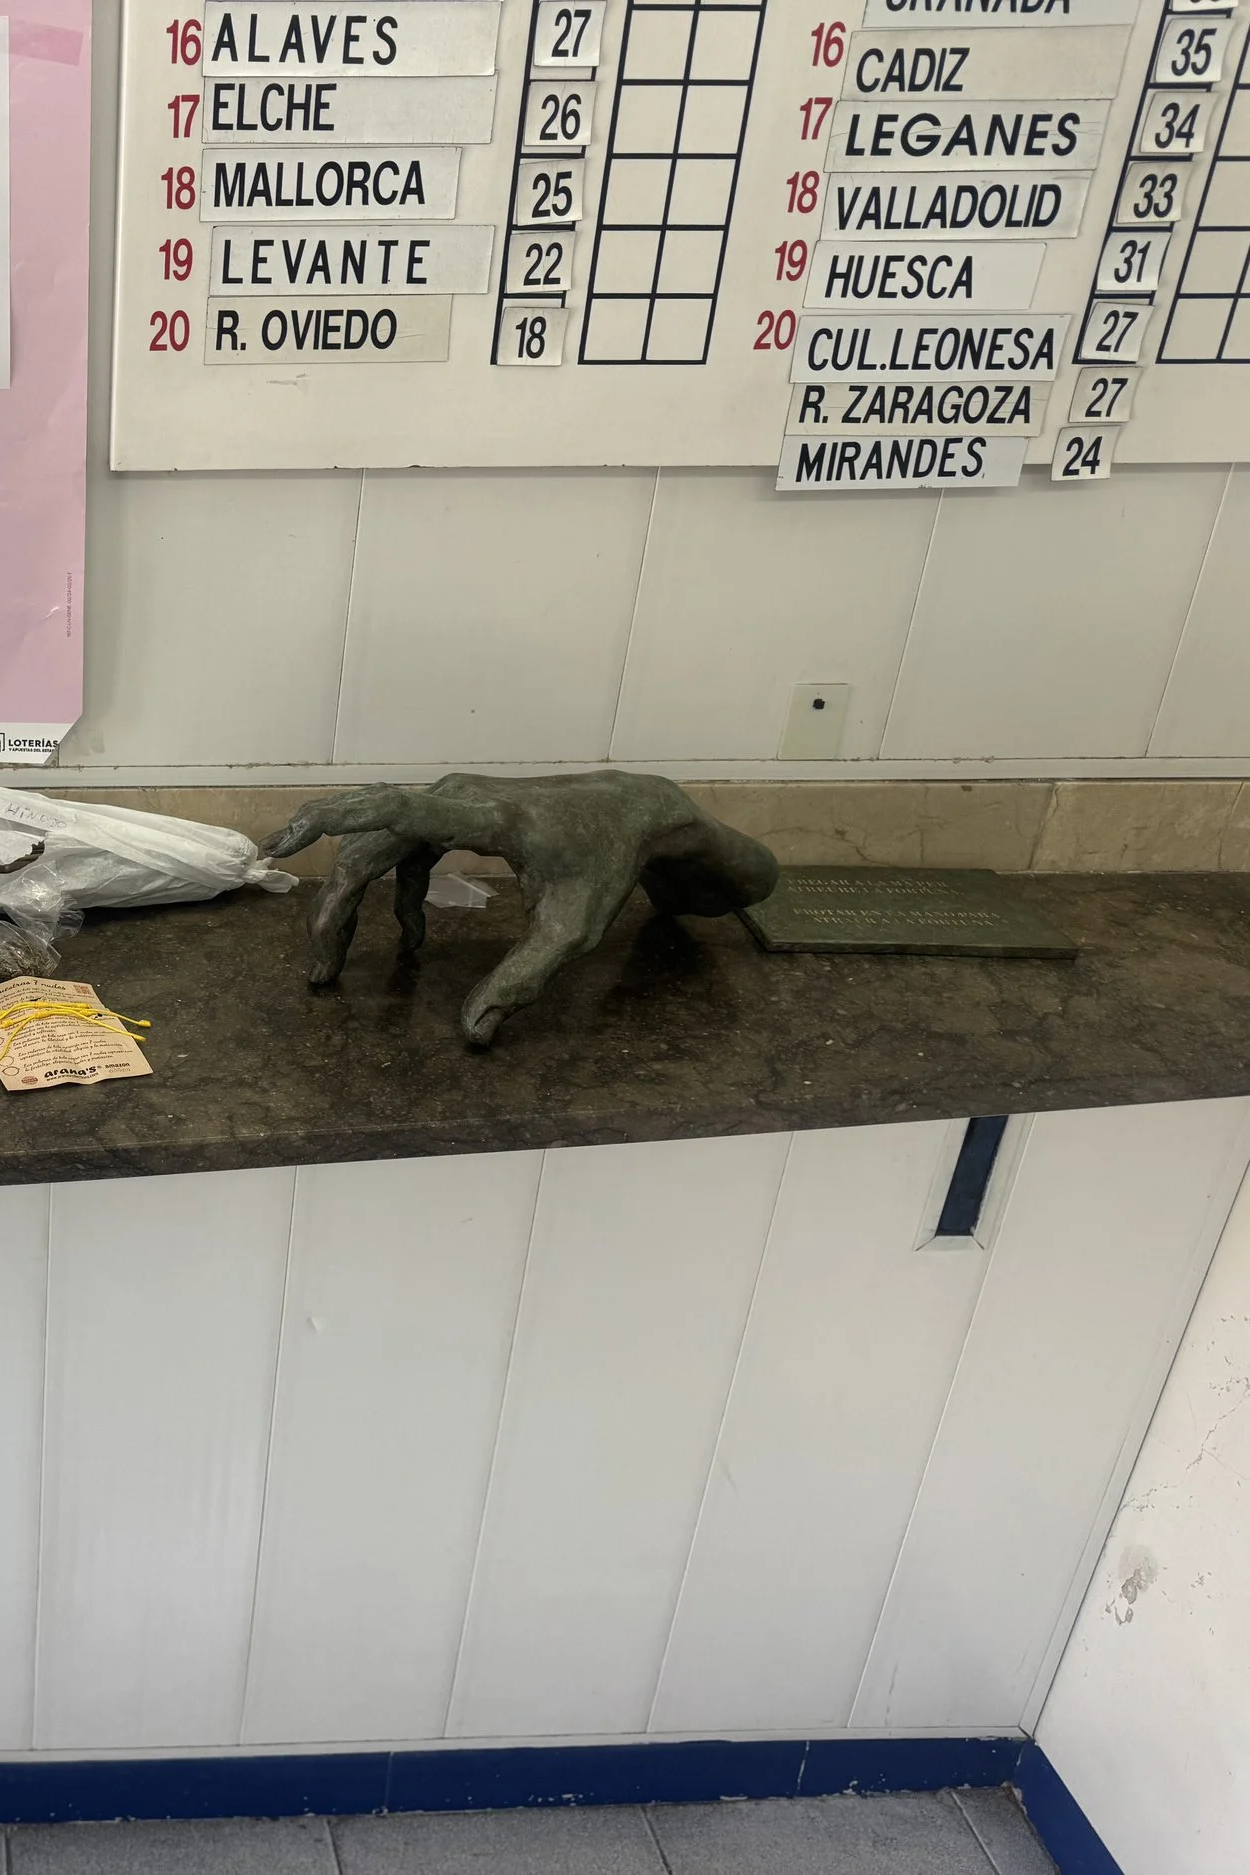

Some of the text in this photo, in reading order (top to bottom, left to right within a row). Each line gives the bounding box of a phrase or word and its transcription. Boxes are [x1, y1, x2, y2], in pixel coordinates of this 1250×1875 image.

[166, 8, 592, 65] 16 ALAVES 27
[810, 21, 1217, 93] 16 CADIZ 35
[167, 82, 582, 142] 17 ELCHE 26
[799, 97, 1201, 157] 17 LEGANES 34
[161, 159, 573, 219] 18 MALLORCA 25
[785, 170, 1178, 231] 18 VALLADOLID 33
[158, 238, 564, 287] 19 LEVANTE 22
[773, 239, 1150, 299] 19 HUESCA 31
[149, 308, 547, 359] 20 R. OVIEDO 18
[753, 309, 1138, 371] 20 CUL.LEONESA 27
[798, 377, 1128, 425] R. ZARAGOZA 27
[795, 436, 1102, 483] MIRANDES 24
[8, 738, 58, 748] LOTERÍAS
